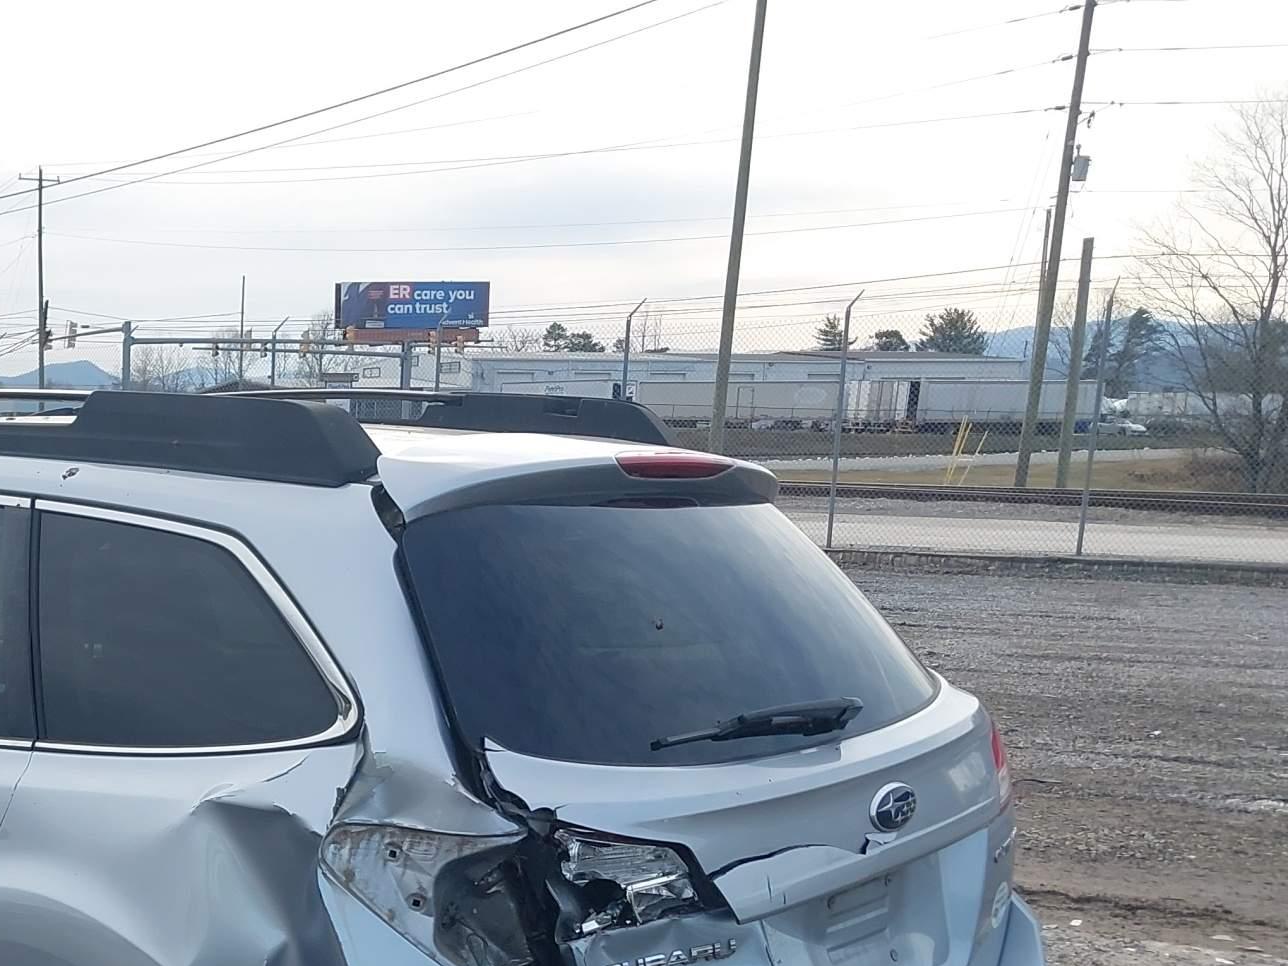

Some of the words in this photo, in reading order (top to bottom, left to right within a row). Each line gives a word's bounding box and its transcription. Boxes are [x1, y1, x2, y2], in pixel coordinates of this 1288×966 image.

[389, 285, 411, 299] ER
[413, 290, 445, 300] care
[449, 289, 475, 303] you
[387, 303, 413, 314] can
[415, 302, 449, 314] trust
